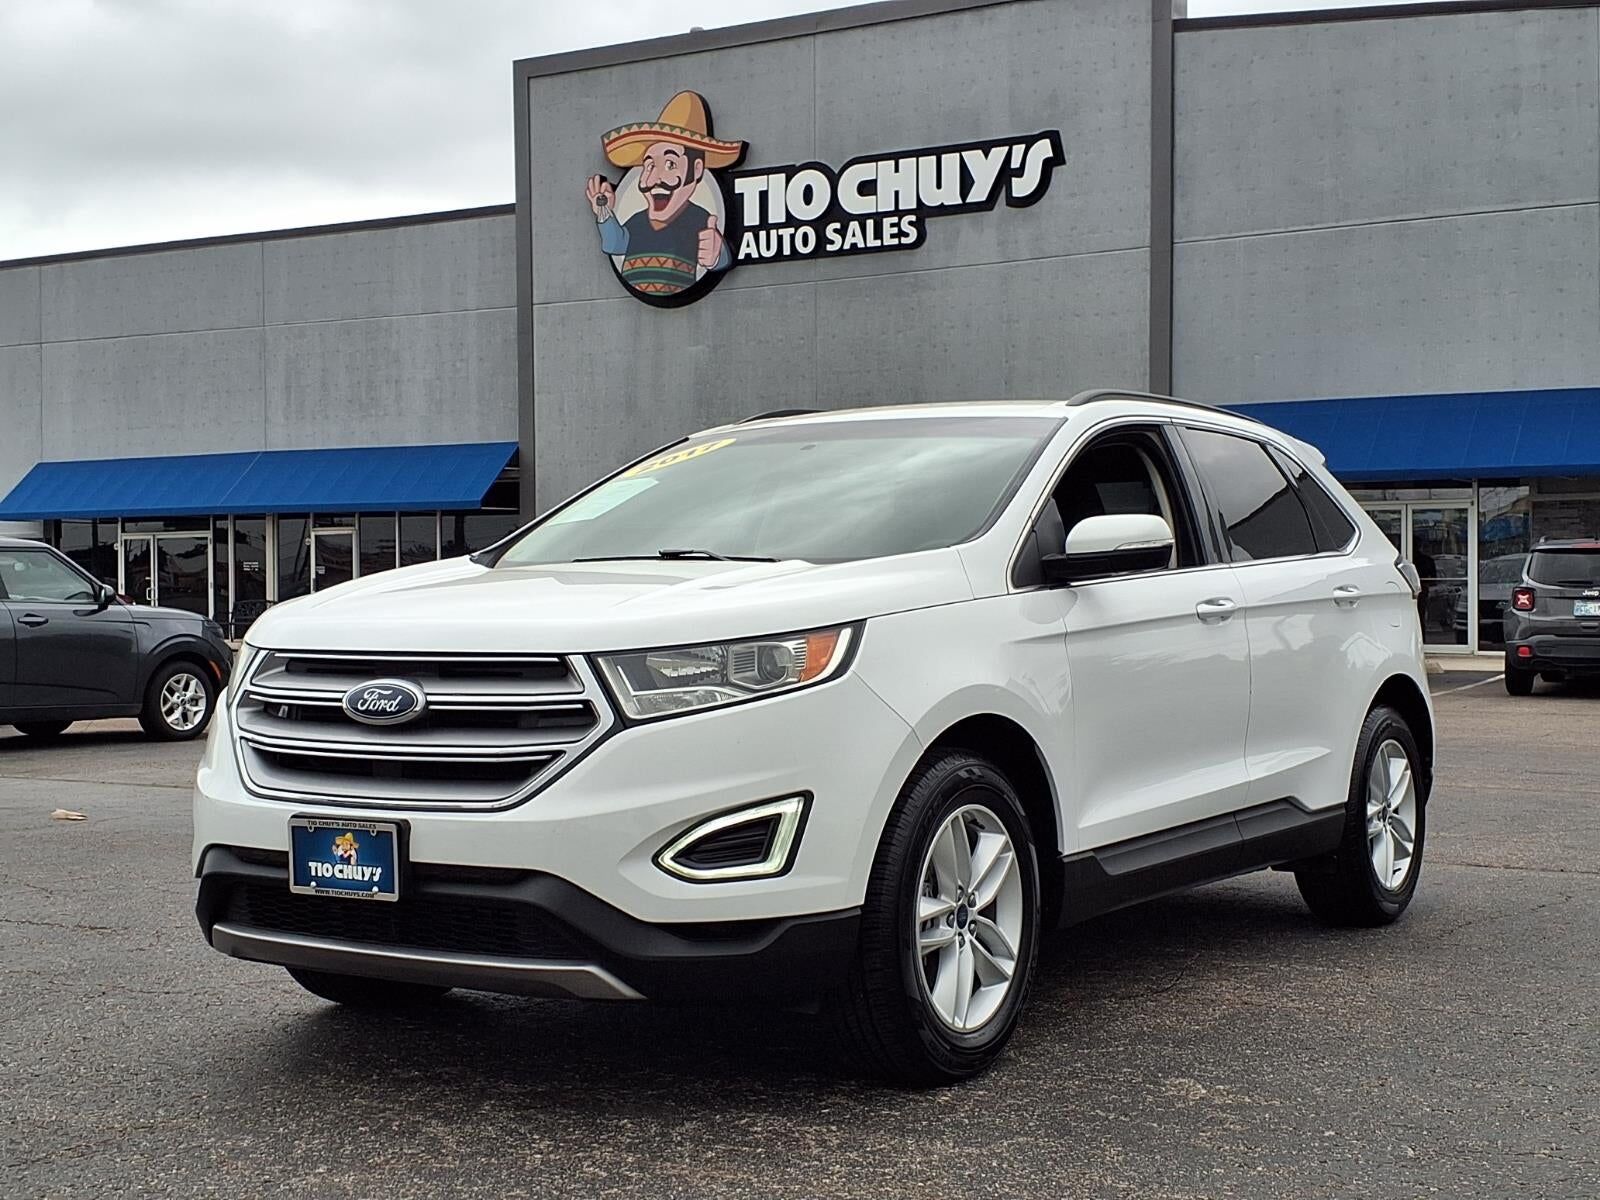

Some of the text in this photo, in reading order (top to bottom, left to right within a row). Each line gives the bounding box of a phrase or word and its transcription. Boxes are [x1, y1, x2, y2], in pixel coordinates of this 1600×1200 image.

[734, 138, 1053, 226] TIO CHUY'S
[737, 215, 918, 260] AUTO SALES
[357, 688, 403, 712] Ford
